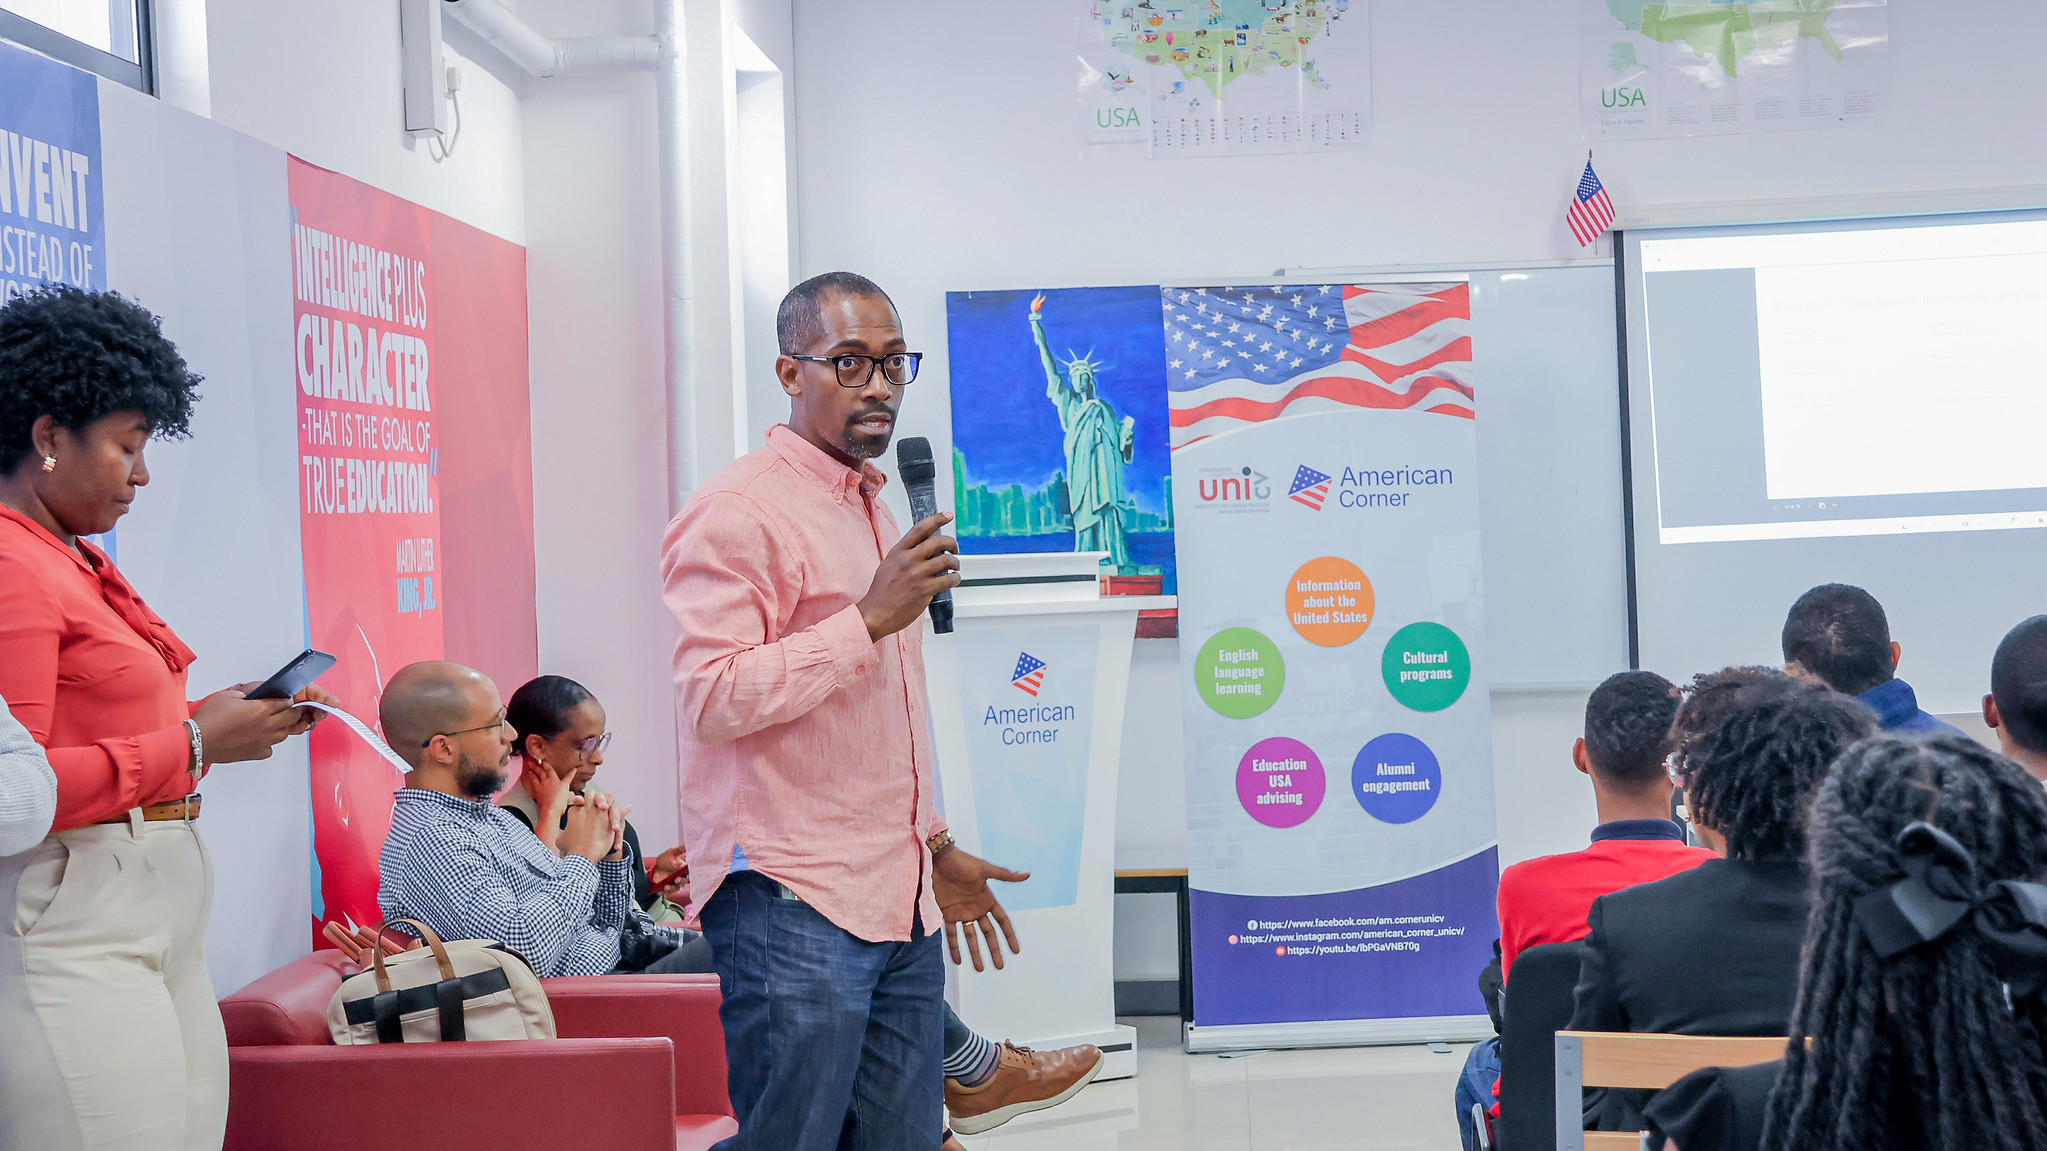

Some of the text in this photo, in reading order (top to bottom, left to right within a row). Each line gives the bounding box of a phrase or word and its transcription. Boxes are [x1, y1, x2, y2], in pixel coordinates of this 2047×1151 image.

[1601, 87, 1646, 108] USA
[1097, 107, 1141, 128] USA
[0, 223, 93, 289] STEAD OF
[394, 253, 428, 330] PLUS
[298, 313, 431, 412] CHARACTER
[341, 412, 353, 447] IS
[355, 413, 378, 449] THE
[381, 416, 414, 452] GOAL
[416, 420, 431, 454] OF
[1340, 465, 1453, 487] American
[303, 455, 345, 515] TRUE
[1339, 490, 1410, 508] Corner
[396, 538, 416, 574] MARTIN
[1296, 579, 1362, 593] Information
[1303, 594, 1357, 609] about the
[1293, 610, 1368, 625] United States
[1219, 649, 1259, 664] English
[1403, 651, 1448, 665] Cultural
[1214, 666, 1265, 680] language
[1400, 668, 1453, 683] programs
[1215, 682, 1262, 696] learning
[984, 702, 1075, 726] American
[1002, 727, 1059, 745] Corner
[1252, 758, 1308, 773] Education
[1376, 762, 1416, 777] Alumni
[1268, 774, 1293, 788] USA
[1362, 778, 1431, 795] engagement
[1256, 791, 1304, 806] advising
